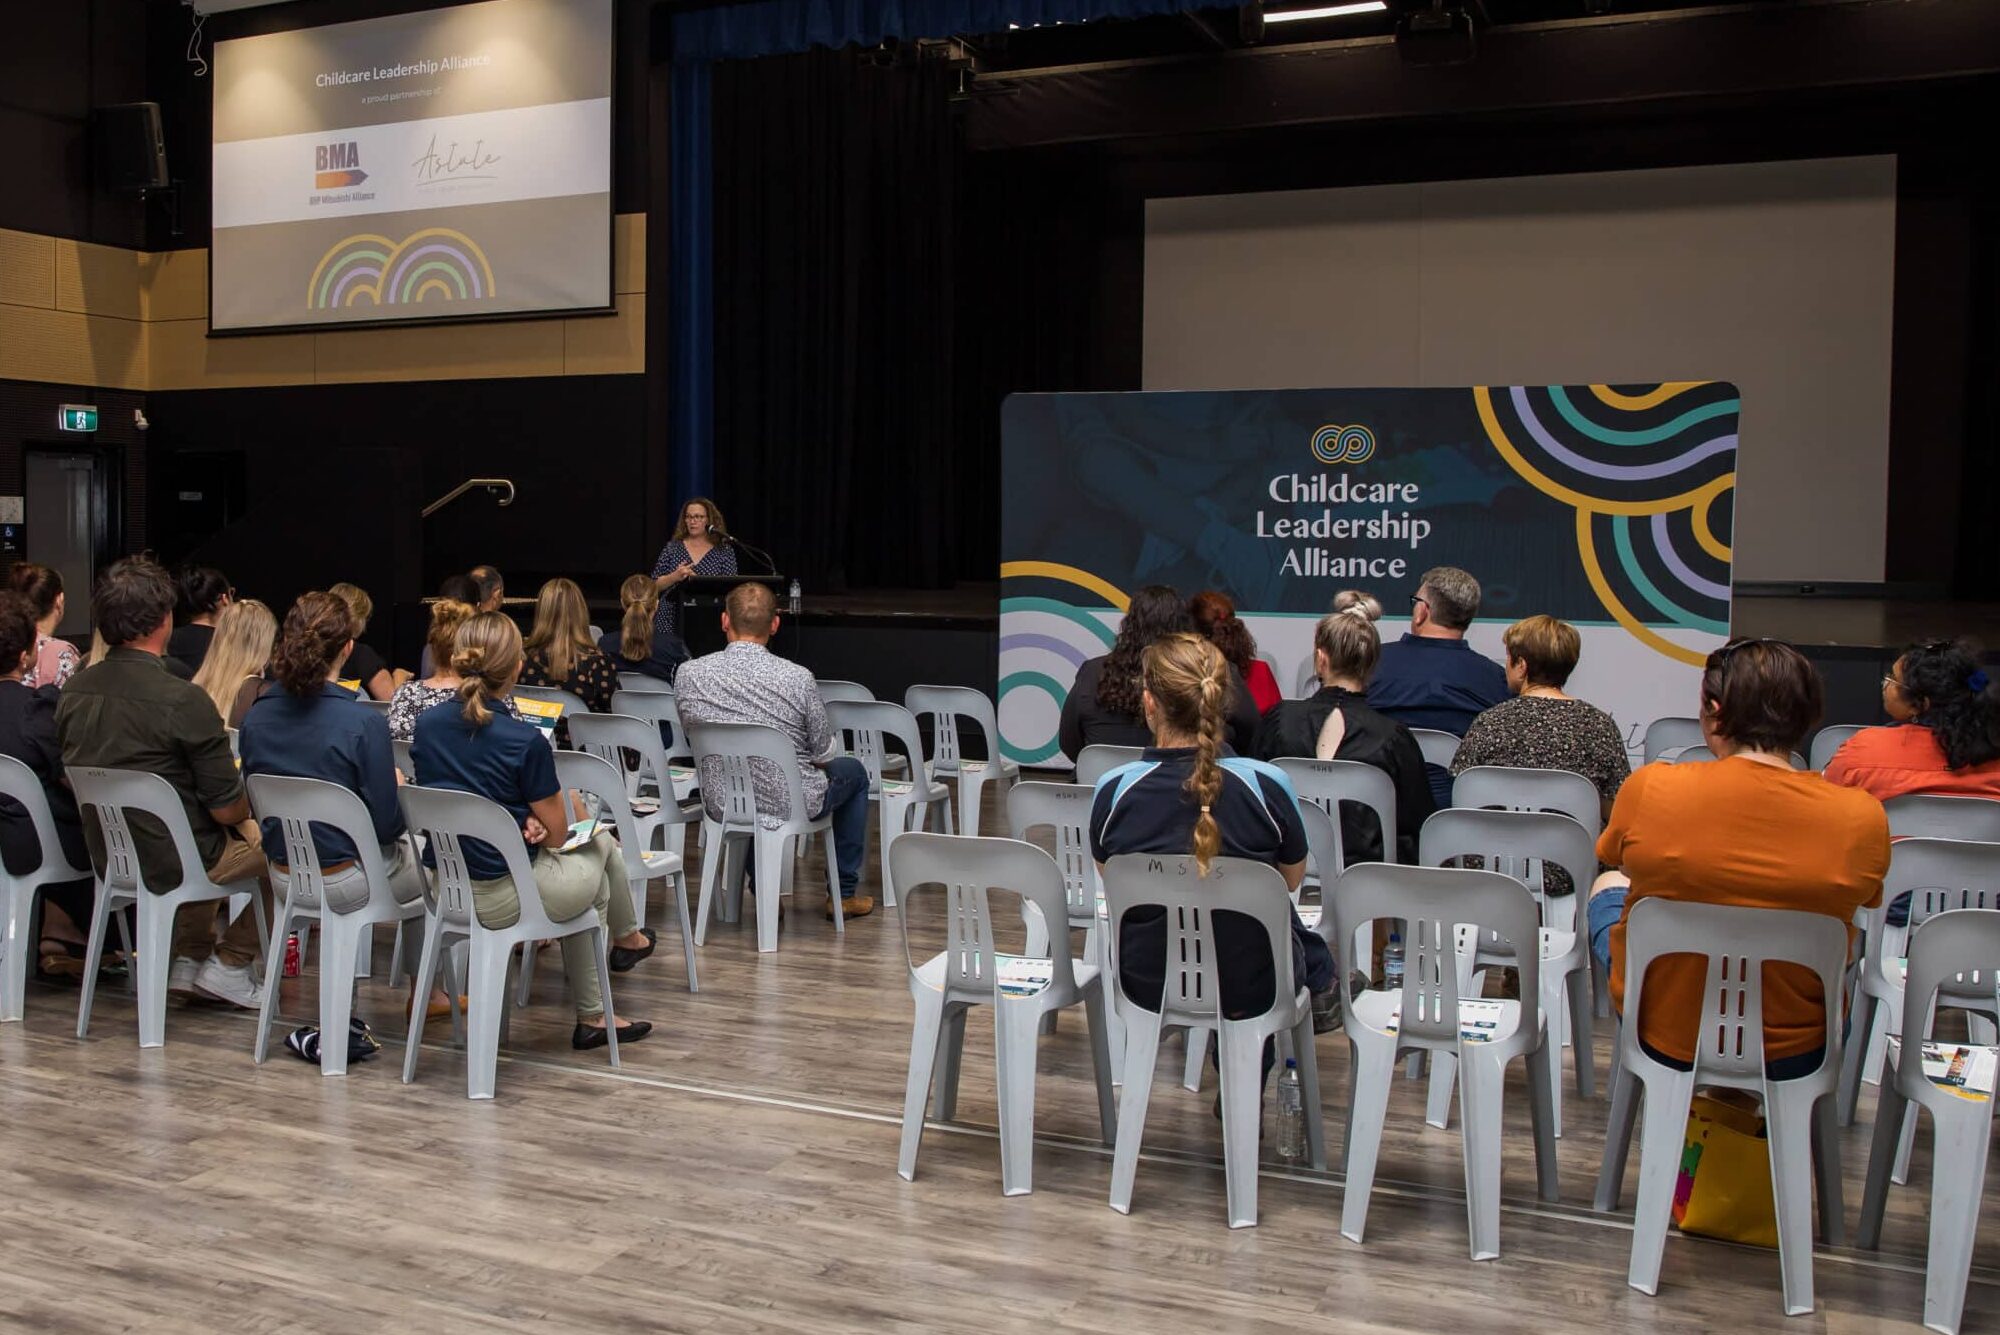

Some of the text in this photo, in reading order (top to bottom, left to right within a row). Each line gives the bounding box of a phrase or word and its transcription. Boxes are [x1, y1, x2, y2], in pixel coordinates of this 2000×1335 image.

[316, 55, 491, 87] Childcare Leadership Alliance
[367, 94, 389, 104] proud
[390, 89, 433, 102] partnership
[316, 142, 359, 171] BMA
[412, 133, 500, 179] Astute
[352, 192, 375, 201] Alliance
[1268, 473, 1419, 503] Childcare
[1257, 509, 1431, 549] Leadership
[1279, 547, 1407, 578] Alliance
